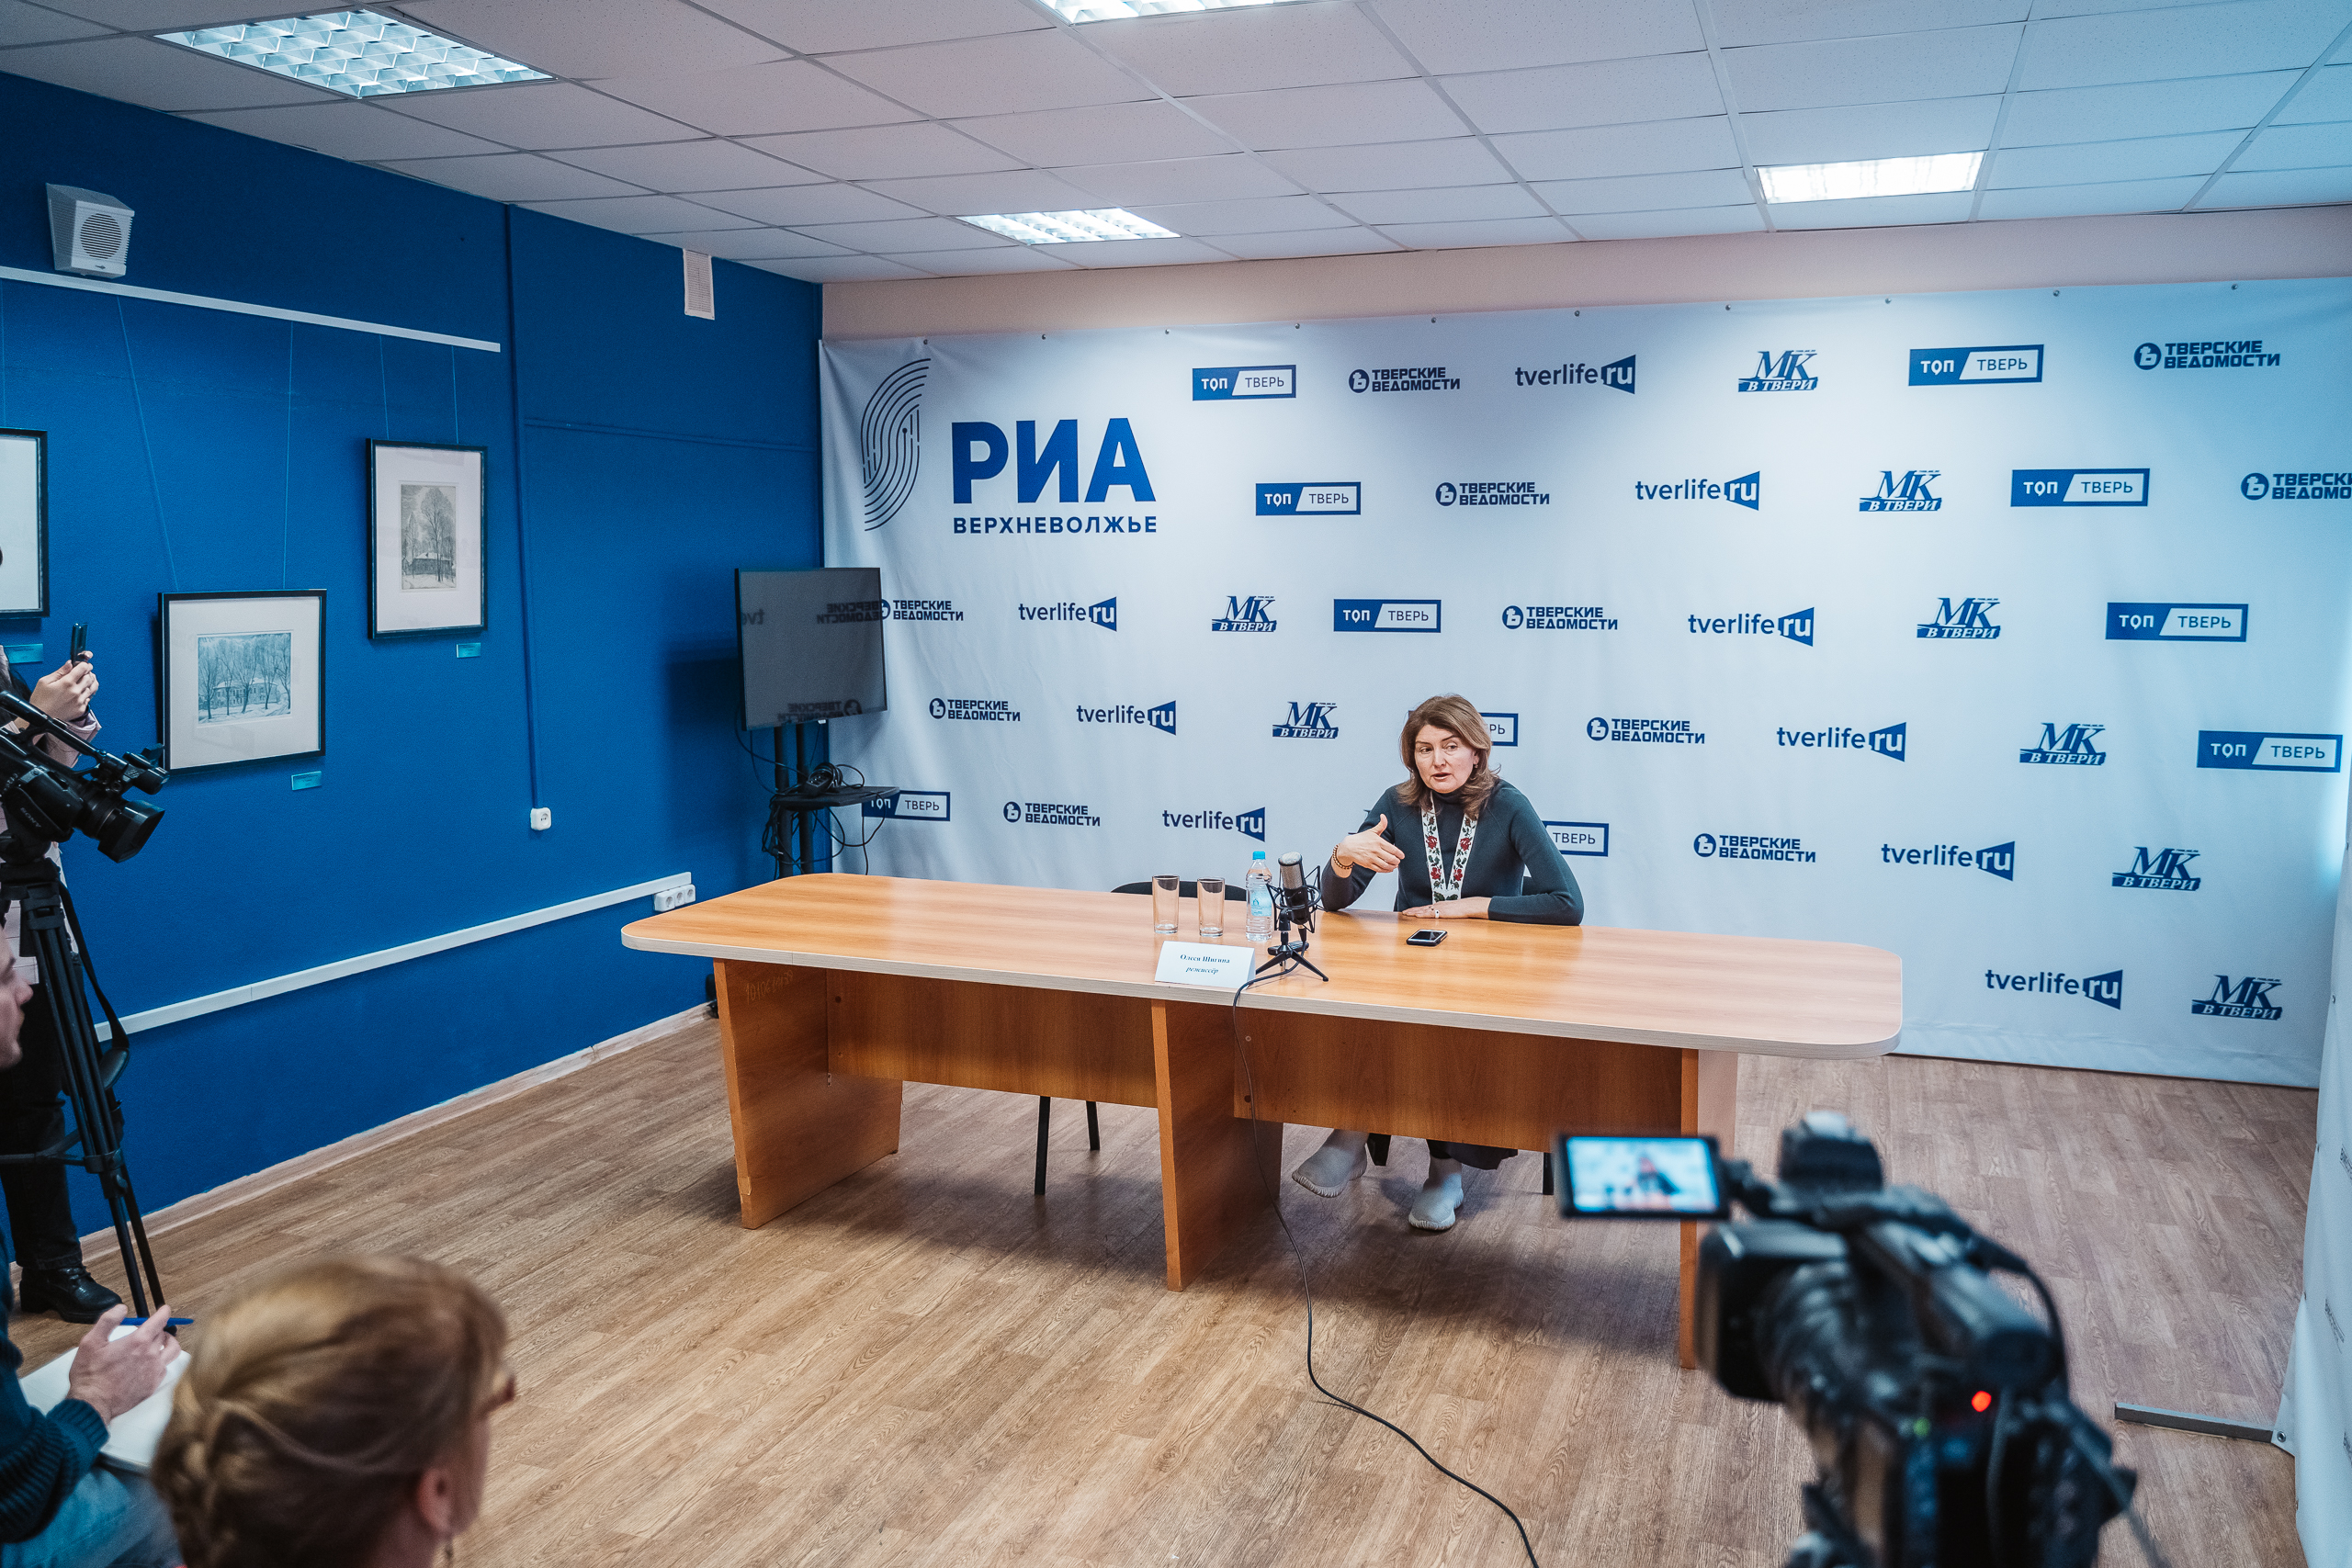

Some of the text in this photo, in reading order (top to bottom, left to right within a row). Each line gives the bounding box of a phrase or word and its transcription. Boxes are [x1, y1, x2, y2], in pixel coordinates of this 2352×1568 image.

[2165, 340, 2263, 355] ТВЕРСКИЕ
[1750, 350, 1817, 379] МК
[1920, 358, 2028, 375] ТОП ТВЕРЬ
[2164, 354, 2280, 368] ВЕДОМОСТИ
[1372, 367, 1446, 380] ТВЕРСКИЕ
[1201, 377, 1284, 391] ТОП ТВЕРЬ
[1372, 378, 1460, 392] ВЕДОМОСТИ
[1747, 379, 1815, 391] В ТВЕРИ
[951, 418, 1156, 504] РИА
[1459, 482, 1535, 493] ТВЕРСКИЕ
[1873, 470, 1941, 500] МК
[2023, 481, 2133, 496] ТОП ТВЕРЬ
[1264, 493, 1349, 507] ТОП ТВЕРЬ
[1459, 493, 1550, 505] ВЕДОМОСТИ
[1868, 500, 1939, 511] В ТВЕРИ
[954, 516, 1156, 534] ВЕРХНЕВОЛЖЬЕ
[893, 600, 952, 610] ТВЕРСКИЕ
[1224, 595, 1276, 622] МК
[1526, 606, 1603, 618] ТВЕРСКИЕ
[1934, 597, 2000, 627] МК
[893, 610, 964, 621] ВЕДОМОСТИ
[1343, 610, 1429, 623] ТОП ТВЕРЬ
[2119, 615, 2231, 629] ТОП ТВЕРЬ
[1218, 622, 1274, 632] В ТВЕРИ
[1526, 618, 1618, 630] ВЕДОМОСТИ
[1926, 627, 1996, 638] В ТВЕРИ
[947, 699, 1008, 711] ТВЕРСКИЕ
[948, 709, 1021, 721] ВЕДОМОСТИ
[1283, 701, 1338, 728] МК
[1611, 718, 1690, 731] ТВЕРСКИЕ
[1279, 728, 1336, 739] В ТВЕРИ
[1611, 730, 1705, 744] ВЕДОМОСТИ
[2035, 722, 2106, 753] МК
[2211, 743, 2325, 759] ТОП ТВЕРЬ
[2029, 752, 2101, 765] В ТВЕРИ
[905, 800, 939, 811] ТВЕРЬ
[1024, 803, 1088, 815] ТВЕРСКИЕ
[1025, 813, 1100, 827] ВЕДОМОСТИ
[1553, 832, 1596, 844] ТВЕРЬ
[1719, 835, 1801, 850] ТВЕРСКИЕ
[1719, 847, 1815, 863] ВЕДОМОСТИ
[2126, 846, 2200, 879] МК
[2121, 876, 2196, 890] В ТВЕРИ
[2207, 975, 2282, 1008] МК
[2201, 1004, 2278, 1020] В ТВЕРИ
